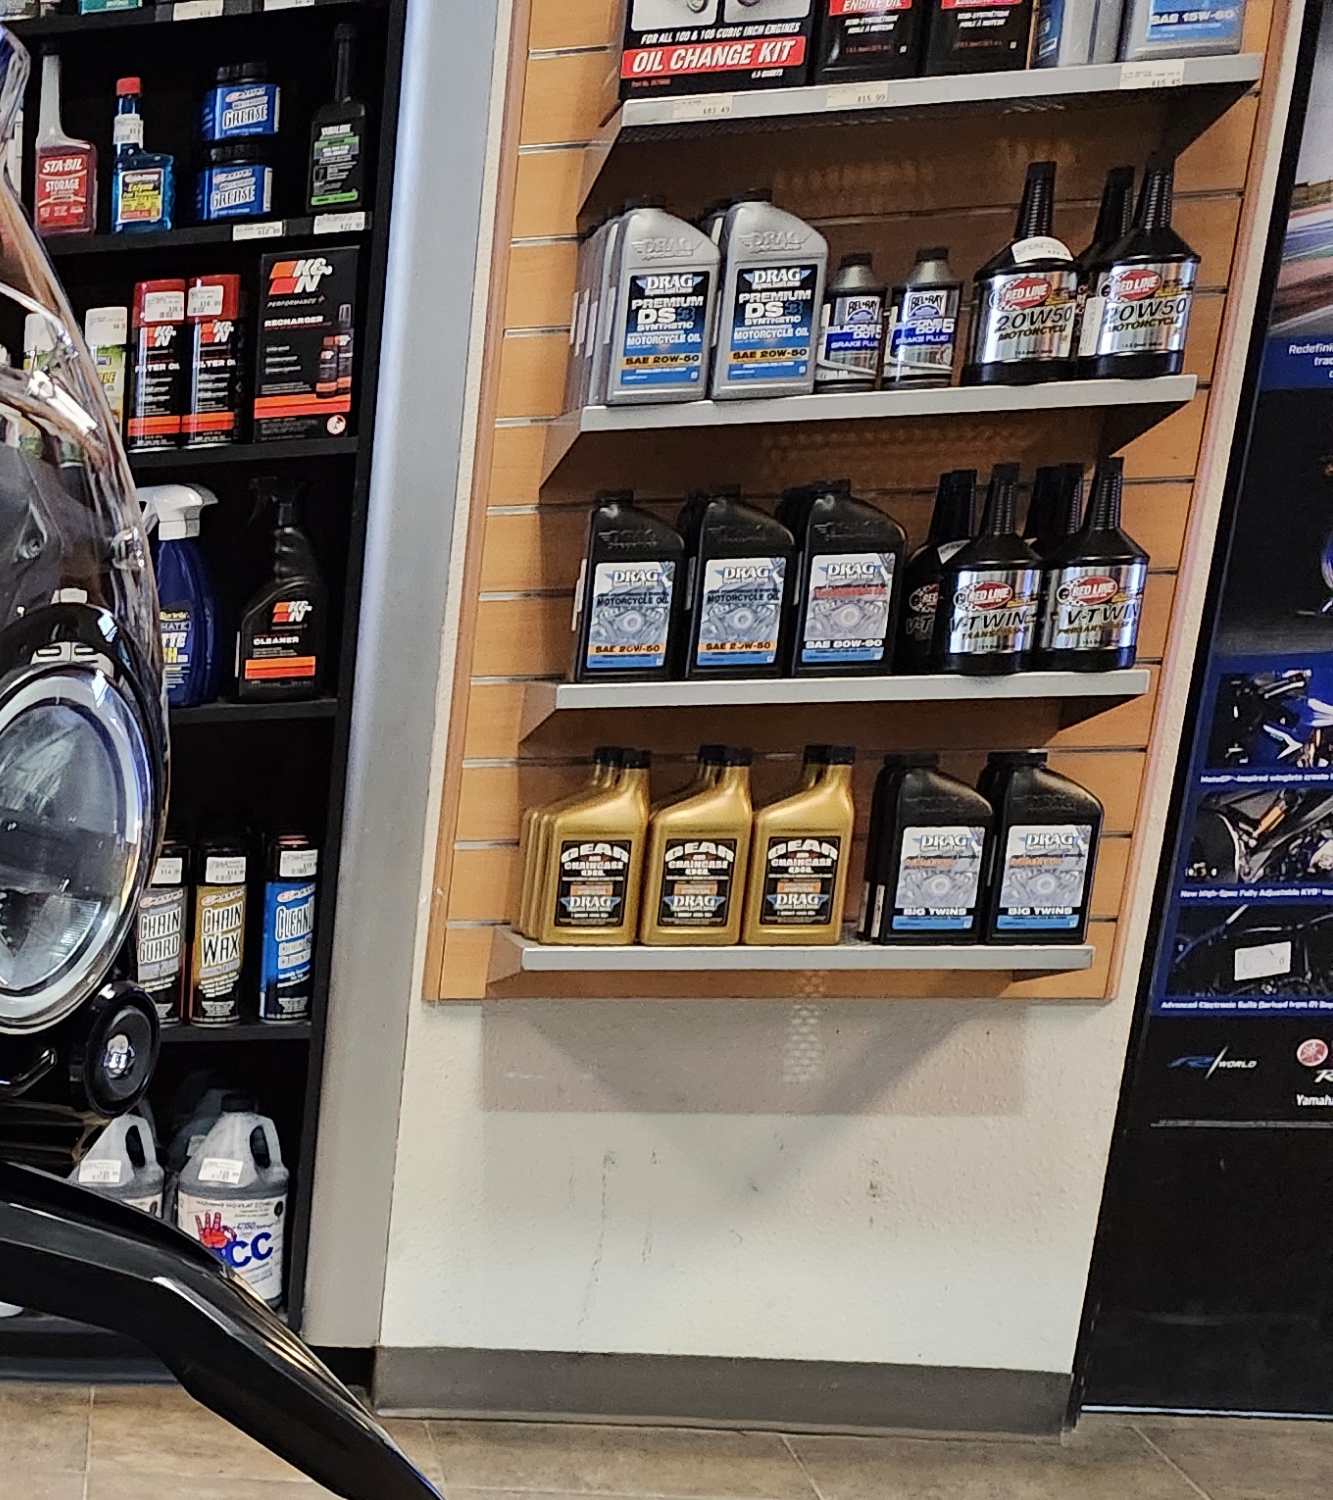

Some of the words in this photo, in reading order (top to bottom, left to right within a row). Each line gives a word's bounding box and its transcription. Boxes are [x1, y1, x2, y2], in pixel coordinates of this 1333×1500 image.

[632, 50, 664, 73] OIL
[669, 43, 753, 70] CHANGE
[758, 39, 797, 63] KIT
[222, 104, 268, 128] GREASE
[45, 177, 80, 191] STORAGE
[211, 185, 256, 209] GREASE
[646, 274, 693, 290] DRAG
[753, 268, 801, 286] DRAG
[1115, 280, 1133, 293] RED
[1134, 274, 1158, 292] LINE
[739, 290, 812, 303] PREMIUM
[1005, 287, 1026, 301] RED
[1026, 282, 1048, 298] LINE
[631, 296, 704, 310] PREMIUM
[264, 316, 324, 327] RECHARGER
[637, 321, 694, 331] SYNTHETIC
[744, 315, 801, 325] SYNTHETIC
[997, 308, 1073, 333] 20W50
[627, 333, 686, 346] MOTORCYCLE
[687, 332, 701, 343] OIL
[733, 328, 793, 340] MOTORCYCLE
[794, 326, 809, 337] OIL
[733, 350, 757, 361] SAE
[613, 570, 658, 583] DRAG
[723, 567, 769, 580] DRAG
[827, 563, 874, 576] DRAG
[969, 590, 985, 602] RED
[986, 588, 1008, 601] LINE
[1071, 586, 1088, 598] RED
[1091, 583, 1115, 596] LINE
[596, 595, 655, 606] MOTORCYCLE
[656, 594, 669, 604] OIL
[707, 593, 766, 604] MOTORCYCLE
[767, 592, 780, 601] OIL
[253, 636, 300, 646] CLEANER
[921, 835, 967, 848] DRAG
[1025, 833, 1073, 846] DRAG
[561, 842, 629, 864] GEAR
[665, 841, 734, 862] GEAR
[767, 839, 838, 860] GEAR
[569, 896, 611, 908] DRAG
[673, 894, 715, 907] DRAG
[776, 893, 819, 906] DRAG
[903, 907, 926, 916] BIG
[929, 907, 967, 916] TWINS
[1008, 907, 1031, 915] BIG
[1034, 906, 1072, 915] TWINS
[140, 907, 181, 939] CHAIN
[202, 902, 242, 934] CHAIN
[139, 936, 180, 963] GUARD
[201, 932, 240, 966] WAX
